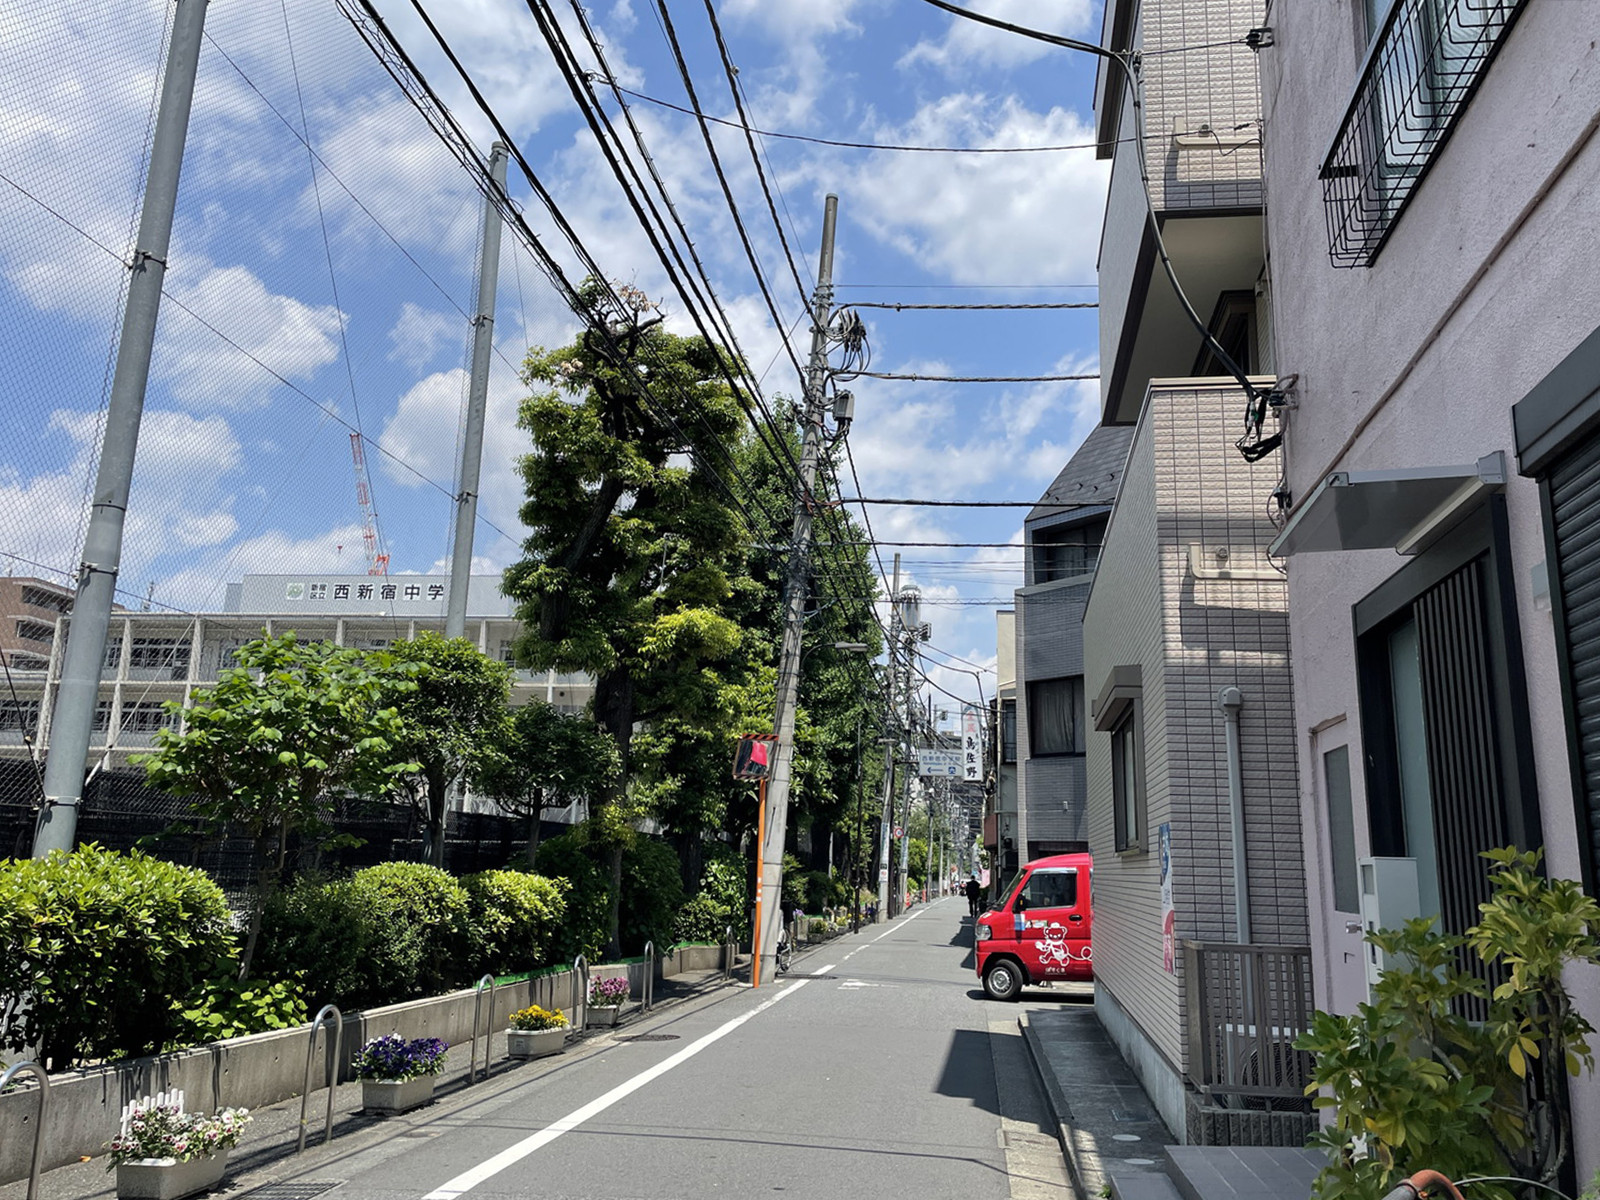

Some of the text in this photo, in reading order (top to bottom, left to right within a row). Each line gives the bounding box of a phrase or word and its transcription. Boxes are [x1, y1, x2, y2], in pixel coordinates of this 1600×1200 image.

[333, 584, 445, 600] 西新宿中学
